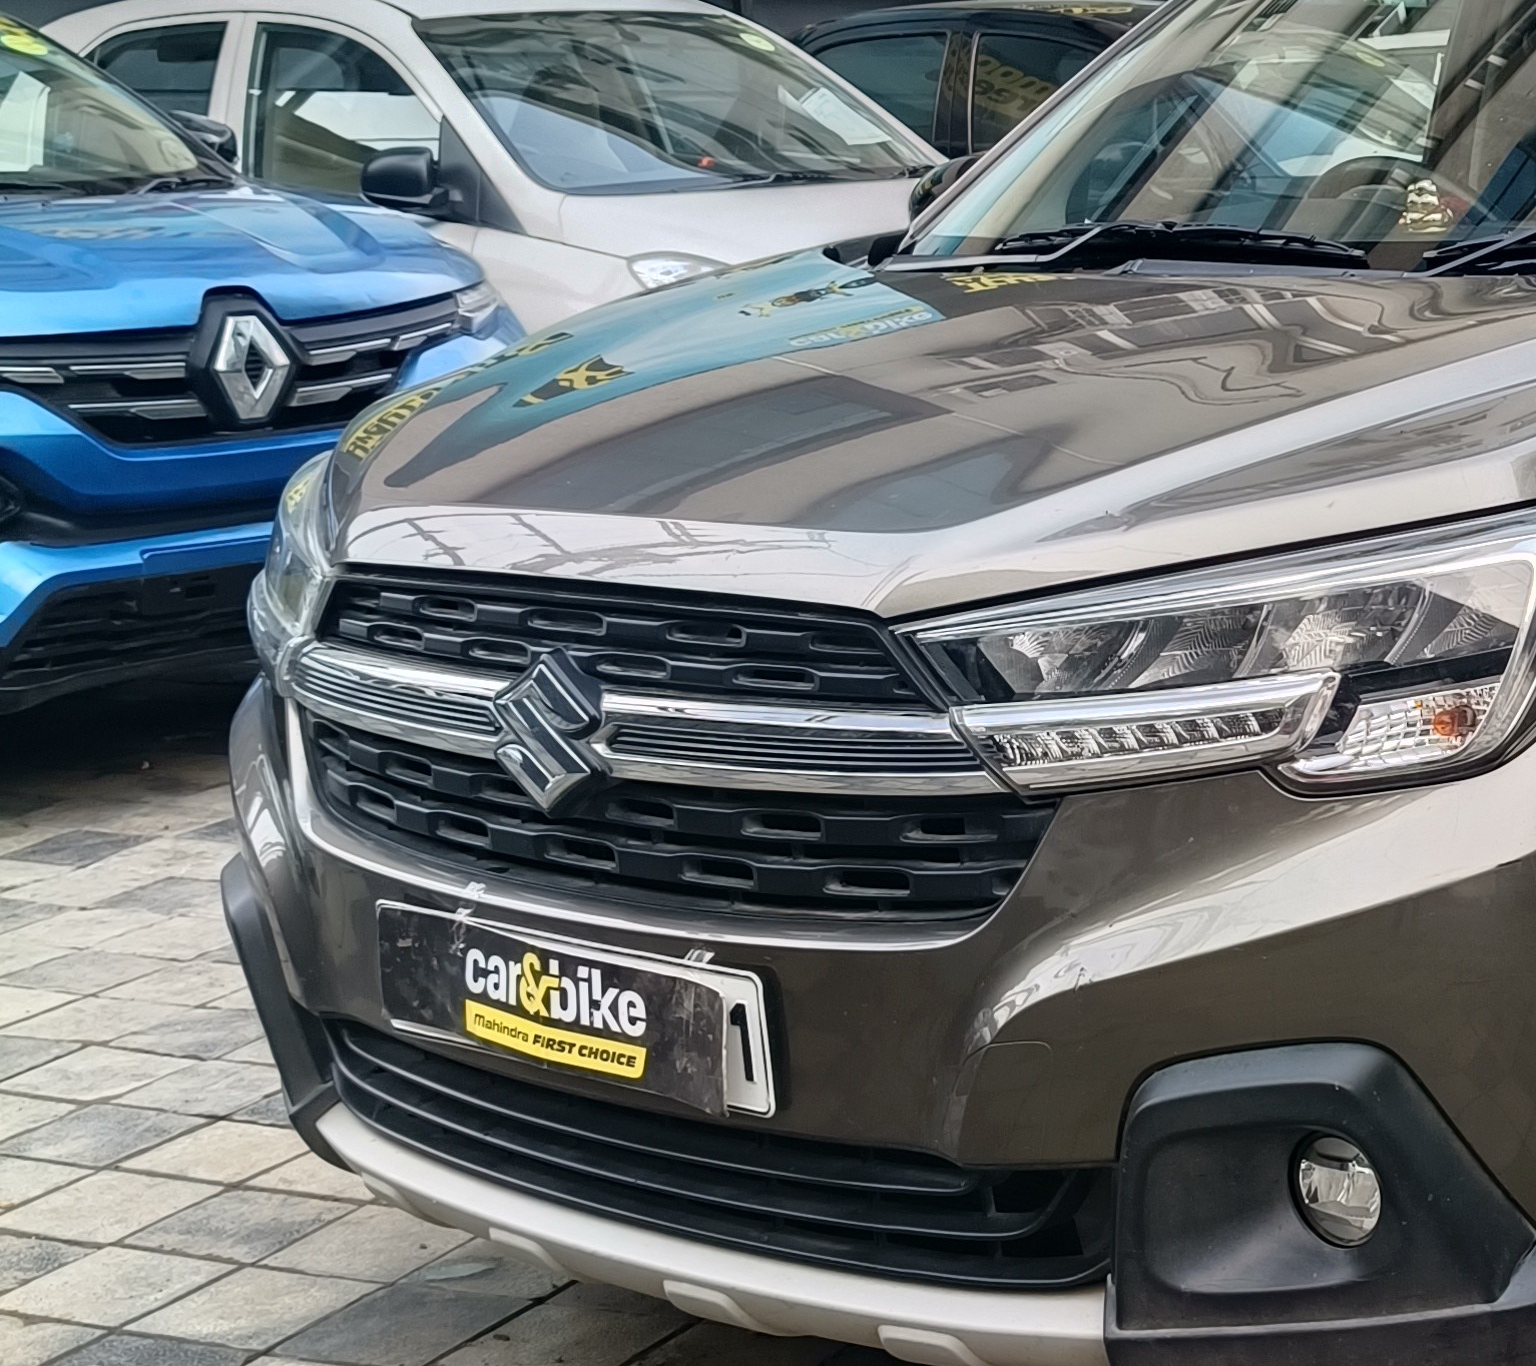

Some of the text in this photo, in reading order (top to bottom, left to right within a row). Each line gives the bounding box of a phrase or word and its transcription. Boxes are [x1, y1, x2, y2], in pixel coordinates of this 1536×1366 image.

[464, 948, 647, 1037] car&bike
[472, 1012, 638, 1068] Mahindra FIRST CHOICE
